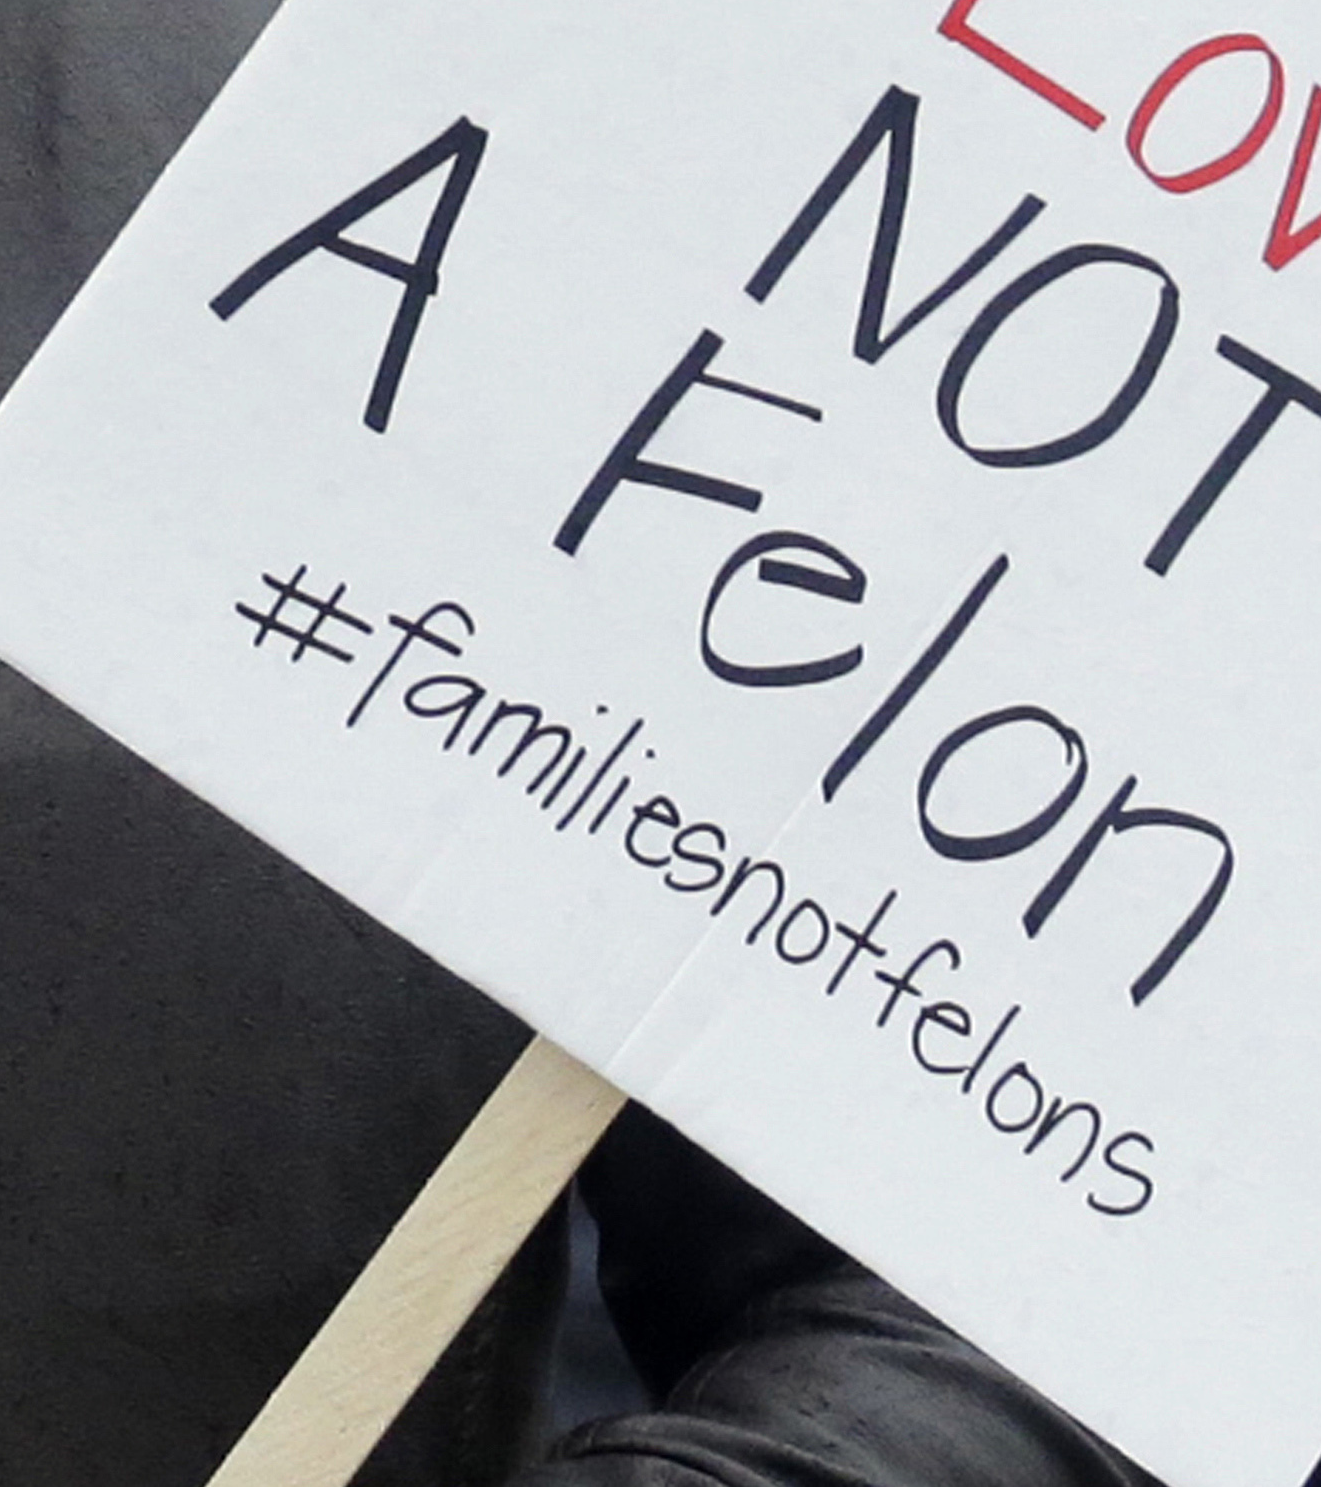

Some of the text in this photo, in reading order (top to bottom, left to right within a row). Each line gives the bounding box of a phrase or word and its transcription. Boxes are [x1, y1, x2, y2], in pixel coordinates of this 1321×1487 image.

[207, 114, 1235, 1008] A Felon
[234, 563, 1155, 1218] #familiesnotfelons
